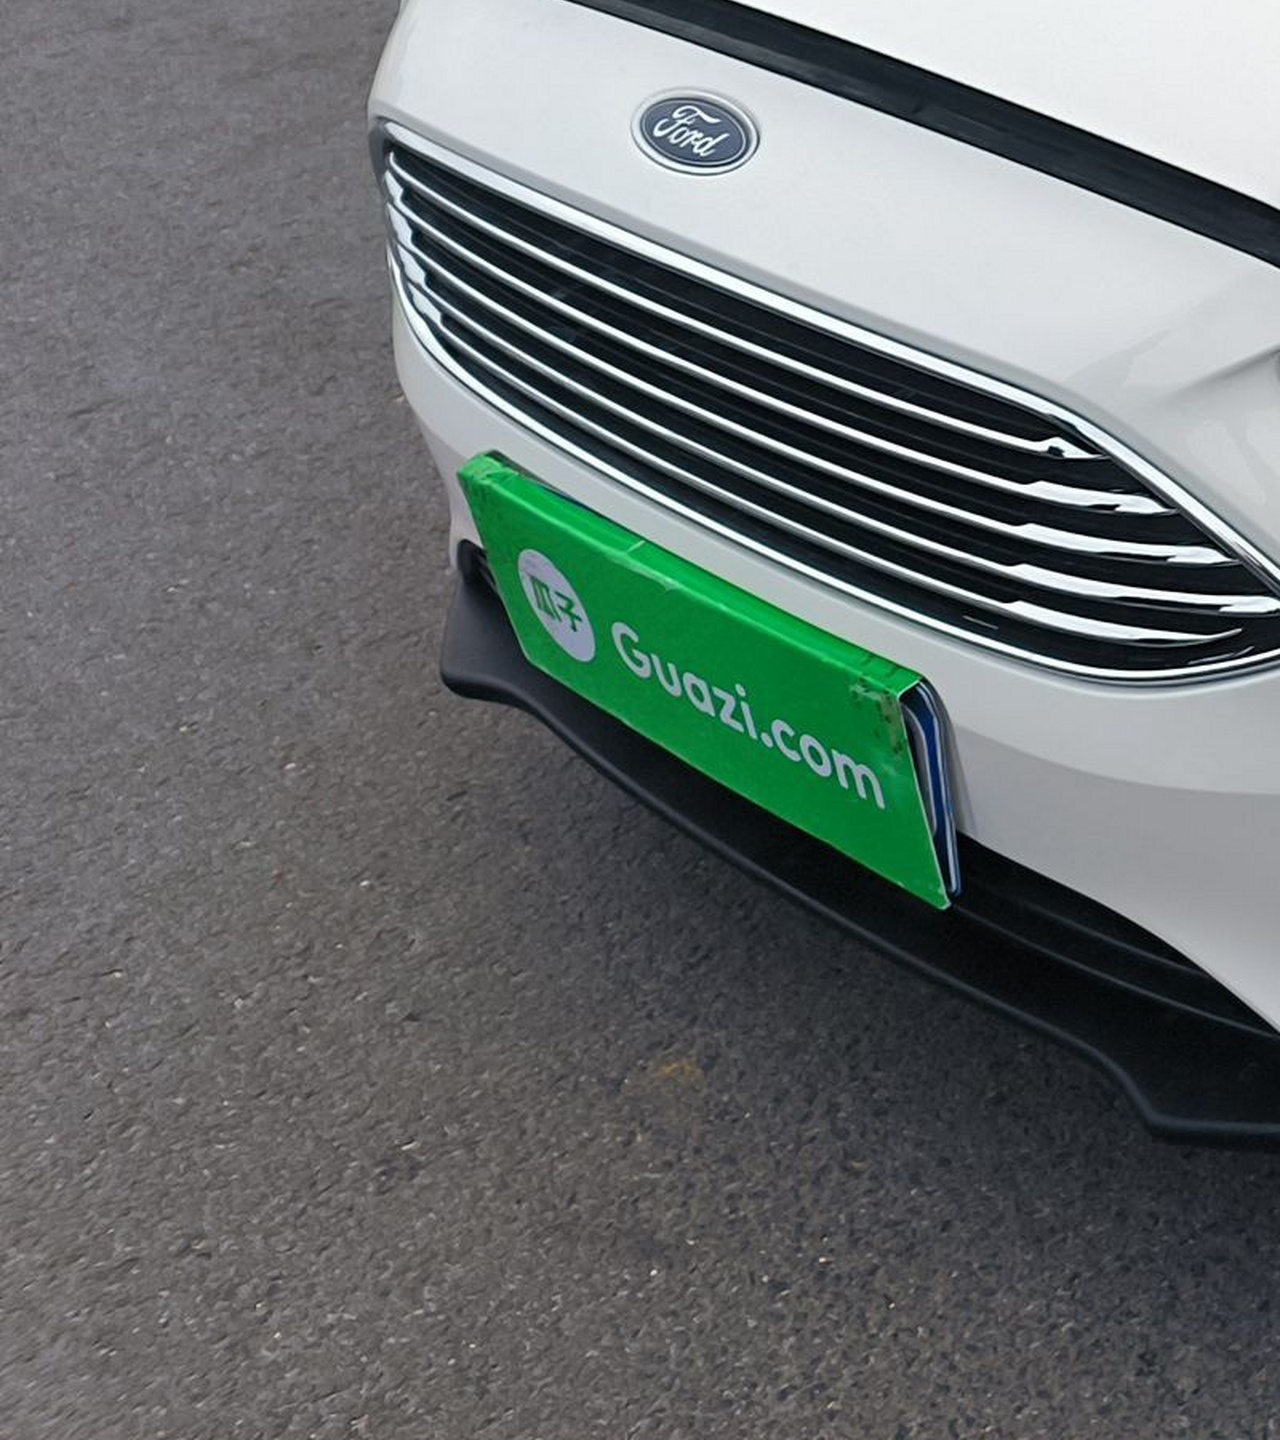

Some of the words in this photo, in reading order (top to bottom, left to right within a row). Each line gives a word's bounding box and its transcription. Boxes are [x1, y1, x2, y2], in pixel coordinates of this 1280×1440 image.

[652, 104, 731, 158] Ford
[524, 570, 584, 633] 瓜子
[610, 621, 886, 810] Guazi.com
